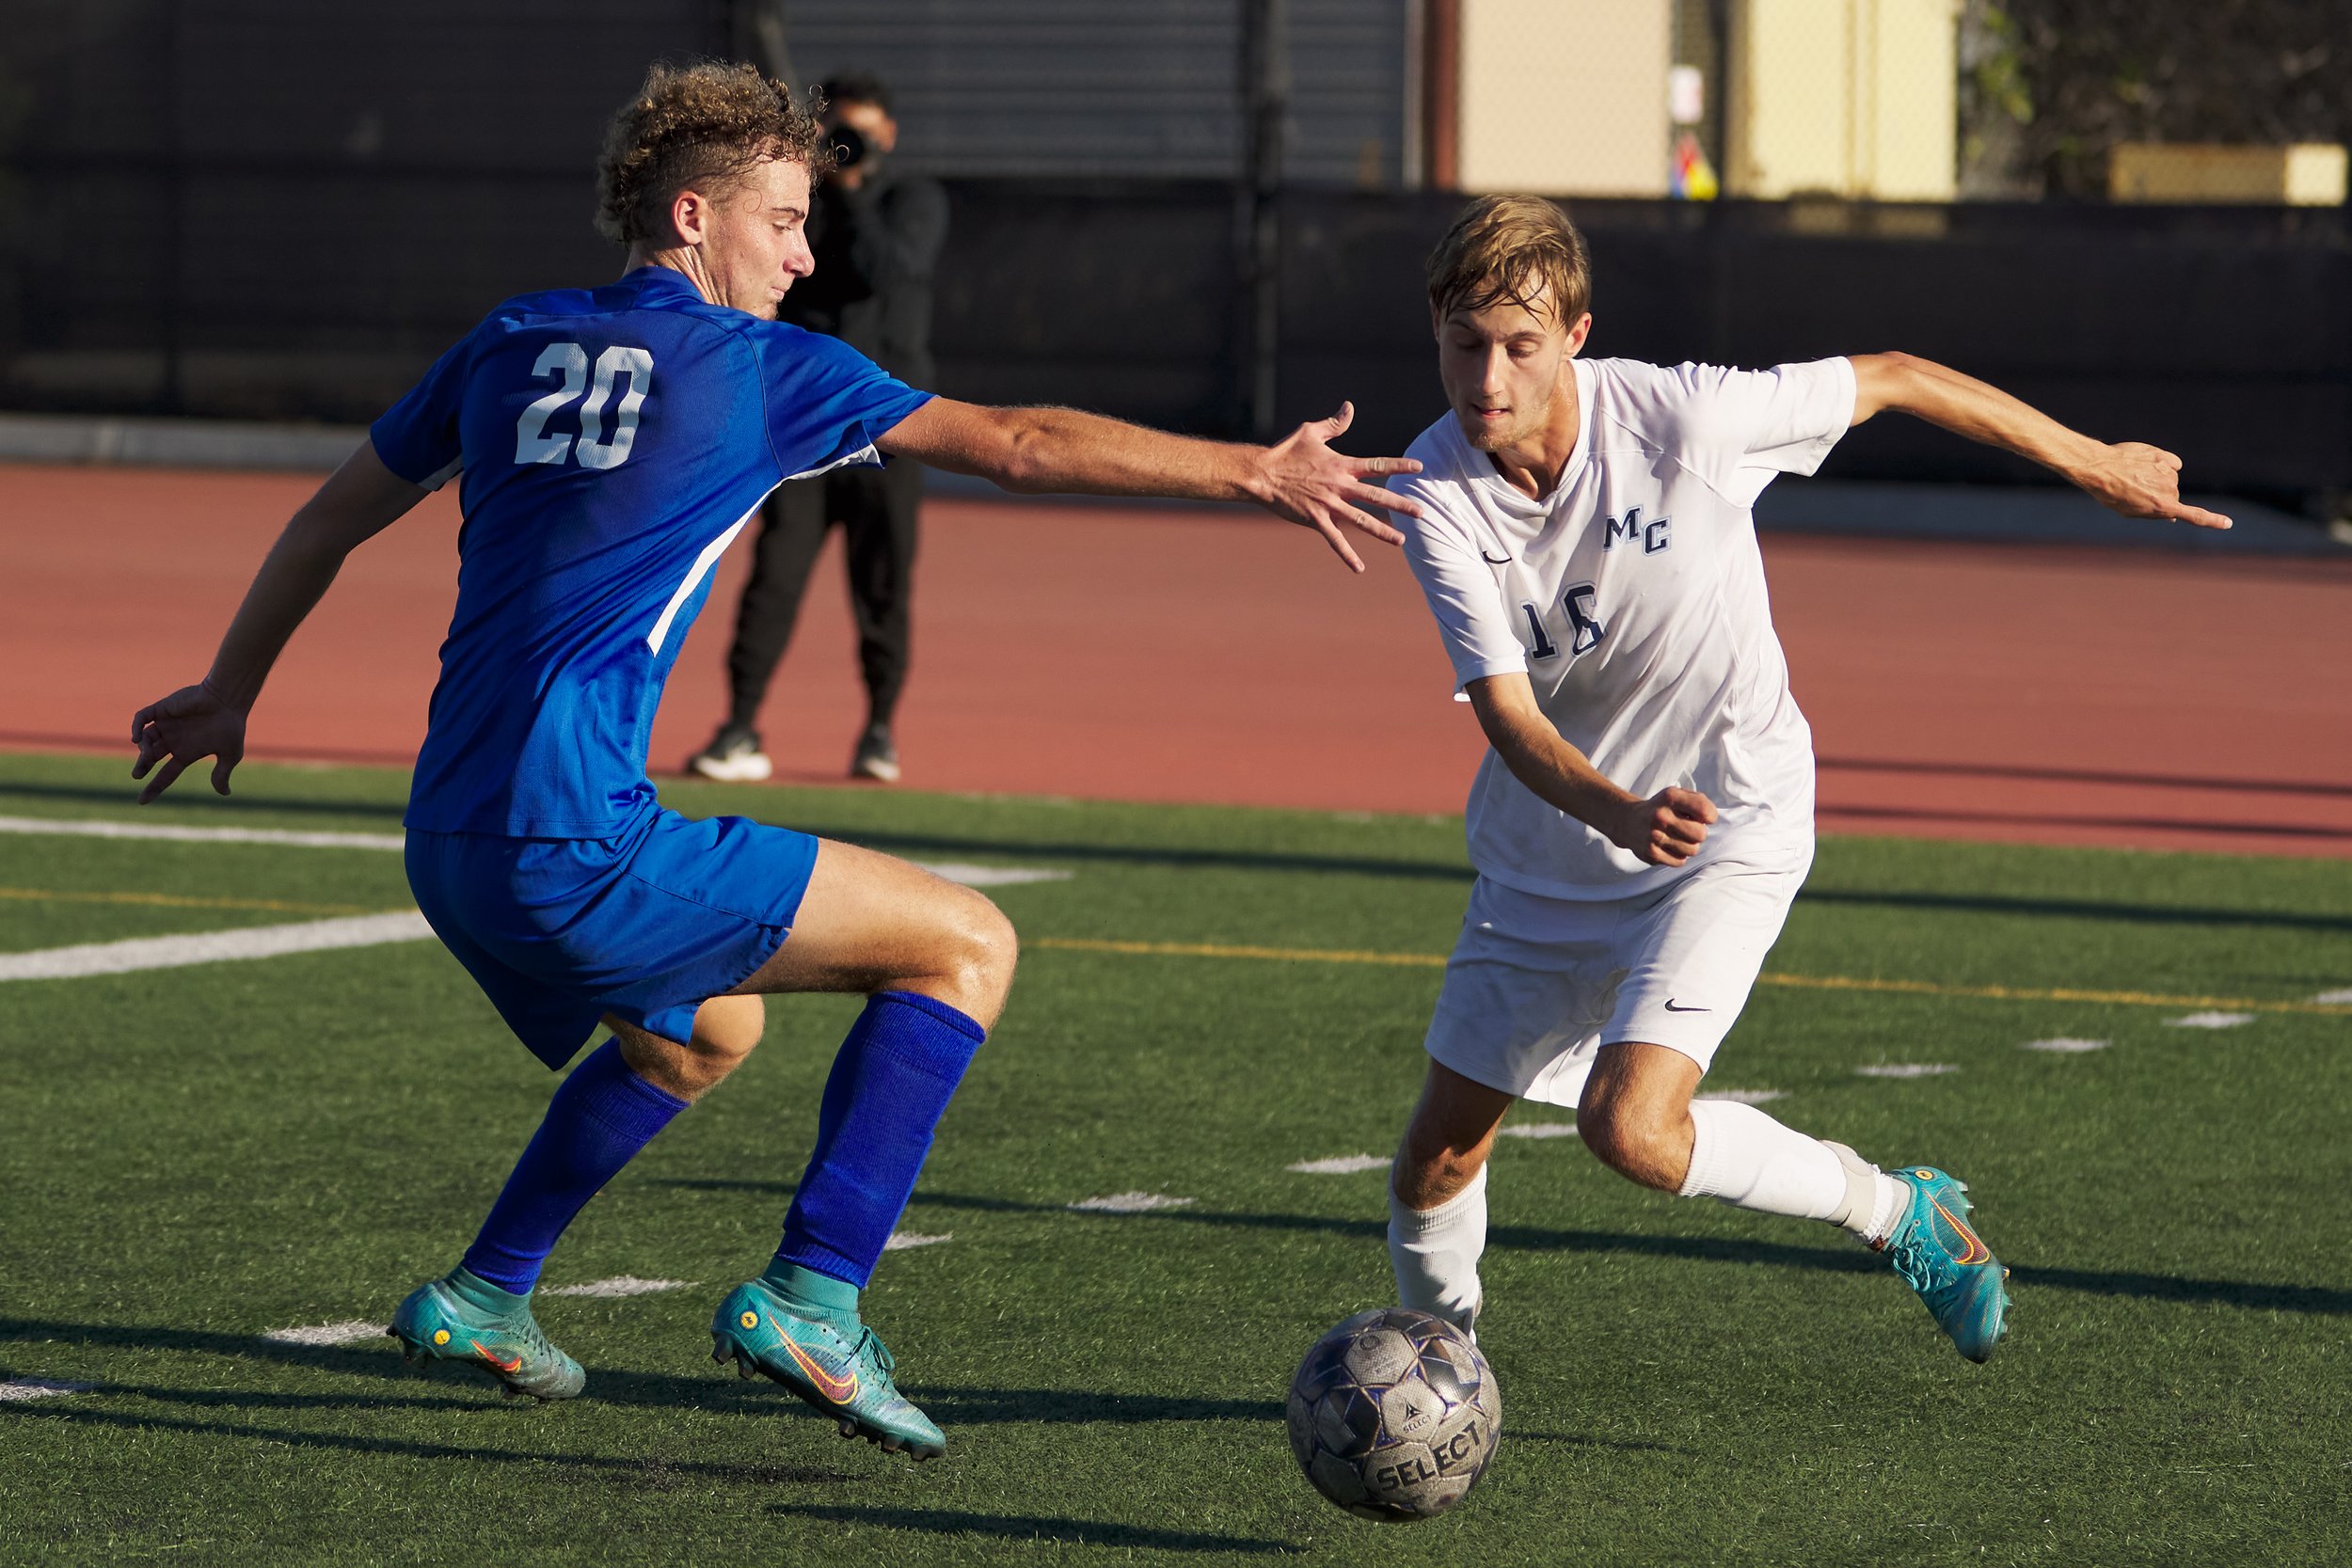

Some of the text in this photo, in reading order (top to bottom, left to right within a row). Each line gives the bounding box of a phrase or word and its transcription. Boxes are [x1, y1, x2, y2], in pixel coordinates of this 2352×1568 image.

[515, 343, 654, 469] 20
[1603, 505, 1671, 556] MC
[1403, 1414, 1432, 1434] SELECT
[1375, 1420, 1481, 1492] SELECT
